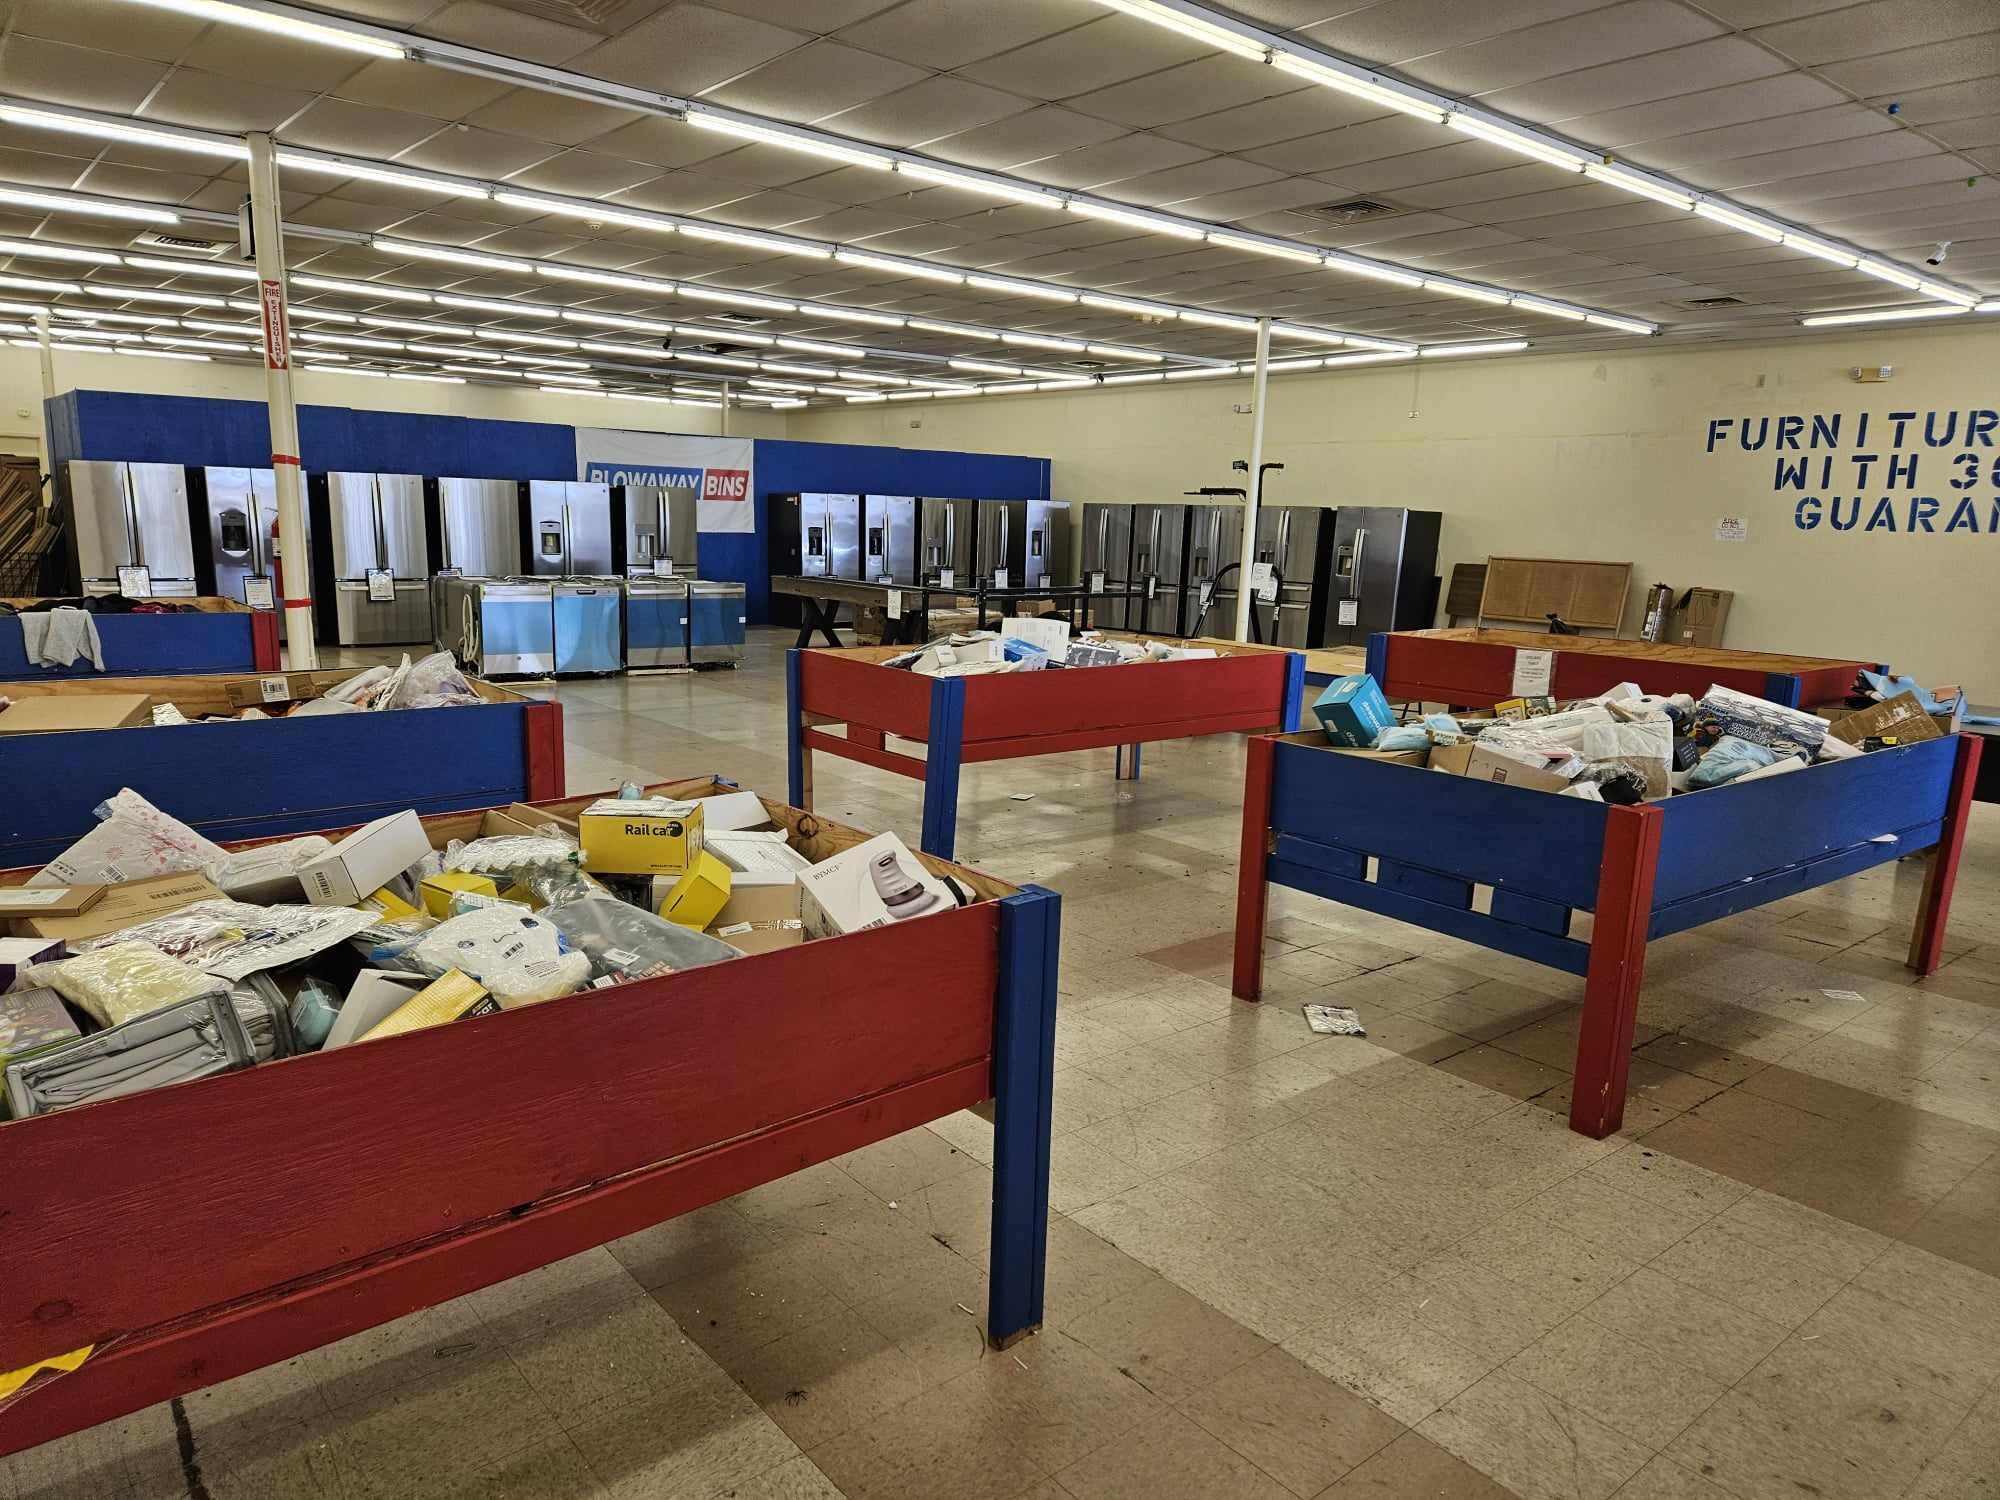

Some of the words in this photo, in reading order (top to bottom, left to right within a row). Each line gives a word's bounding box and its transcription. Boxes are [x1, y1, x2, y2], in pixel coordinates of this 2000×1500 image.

[265, 288, 280, 298] FIRE
[1706, 410, 2000, 452] FURNITUR
[1774, 453, 1919, 490] WITH
[706, 476, 746, 497] BINS
[625, 824, 650, 836] Rail
